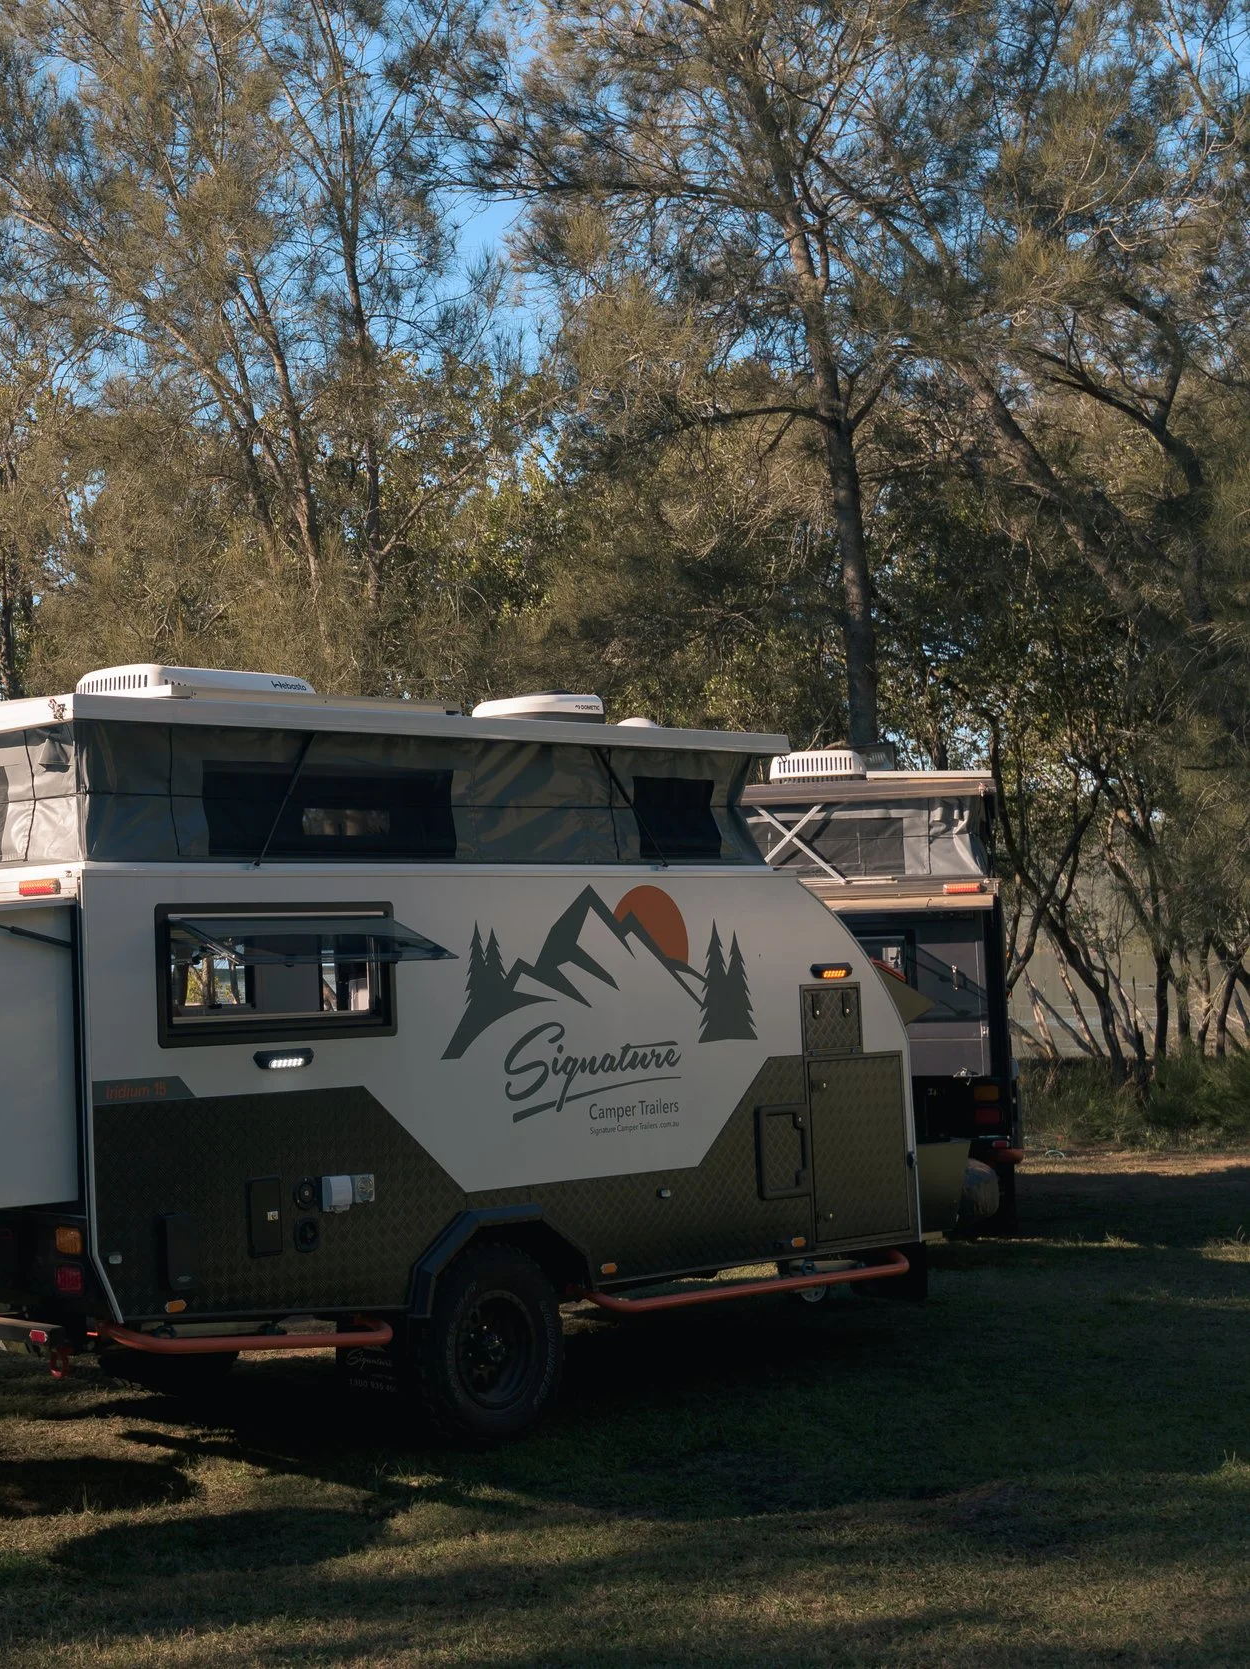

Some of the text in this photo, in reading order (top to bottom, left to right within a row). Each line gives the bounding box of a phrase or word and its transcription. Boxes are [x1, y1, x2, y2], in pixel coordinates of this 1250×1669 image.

[271, 680, 307, 691] Webasto
[504, 1021, 682, 1113] Signature
[105, 1084, 150, 1100] Iridium
[589, 1098, 679, 1122] Camper Trailers
[590, 1126, 616, 1136] Signature
[617, 1124, 638, 1133] Camper
